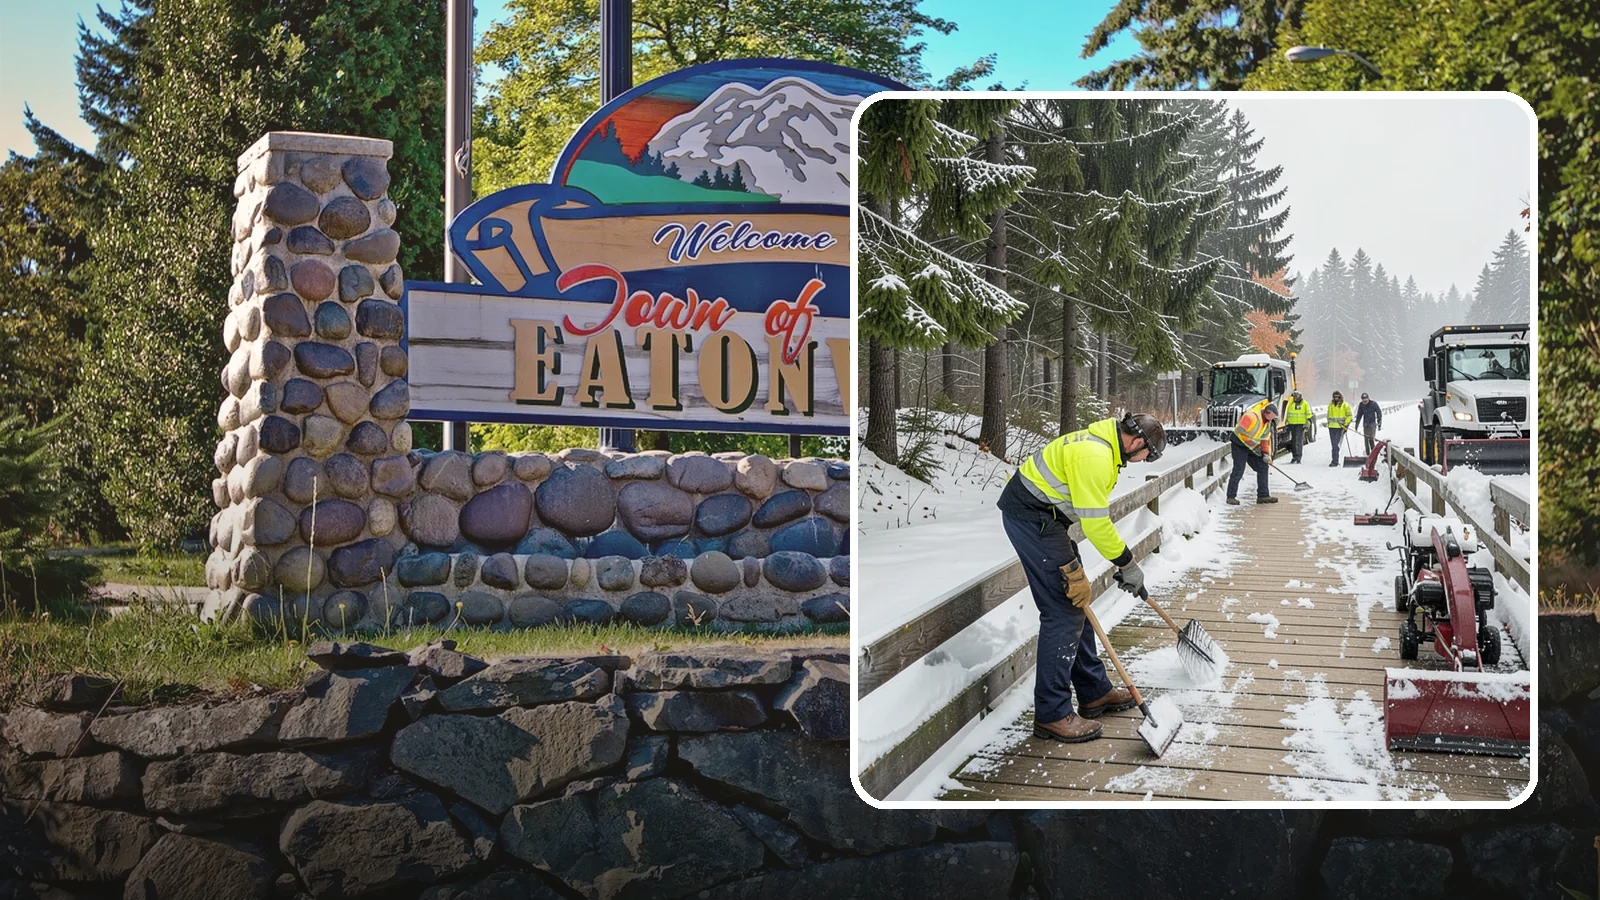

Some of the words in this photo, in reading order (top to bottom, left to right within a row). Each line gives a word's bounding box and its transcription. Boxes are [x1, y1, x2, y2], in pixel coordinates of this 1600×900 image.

[653, 221, 837, 263] Welcome
[556, 264, 736, 336] Town
[765, 278, 826, 365] of
